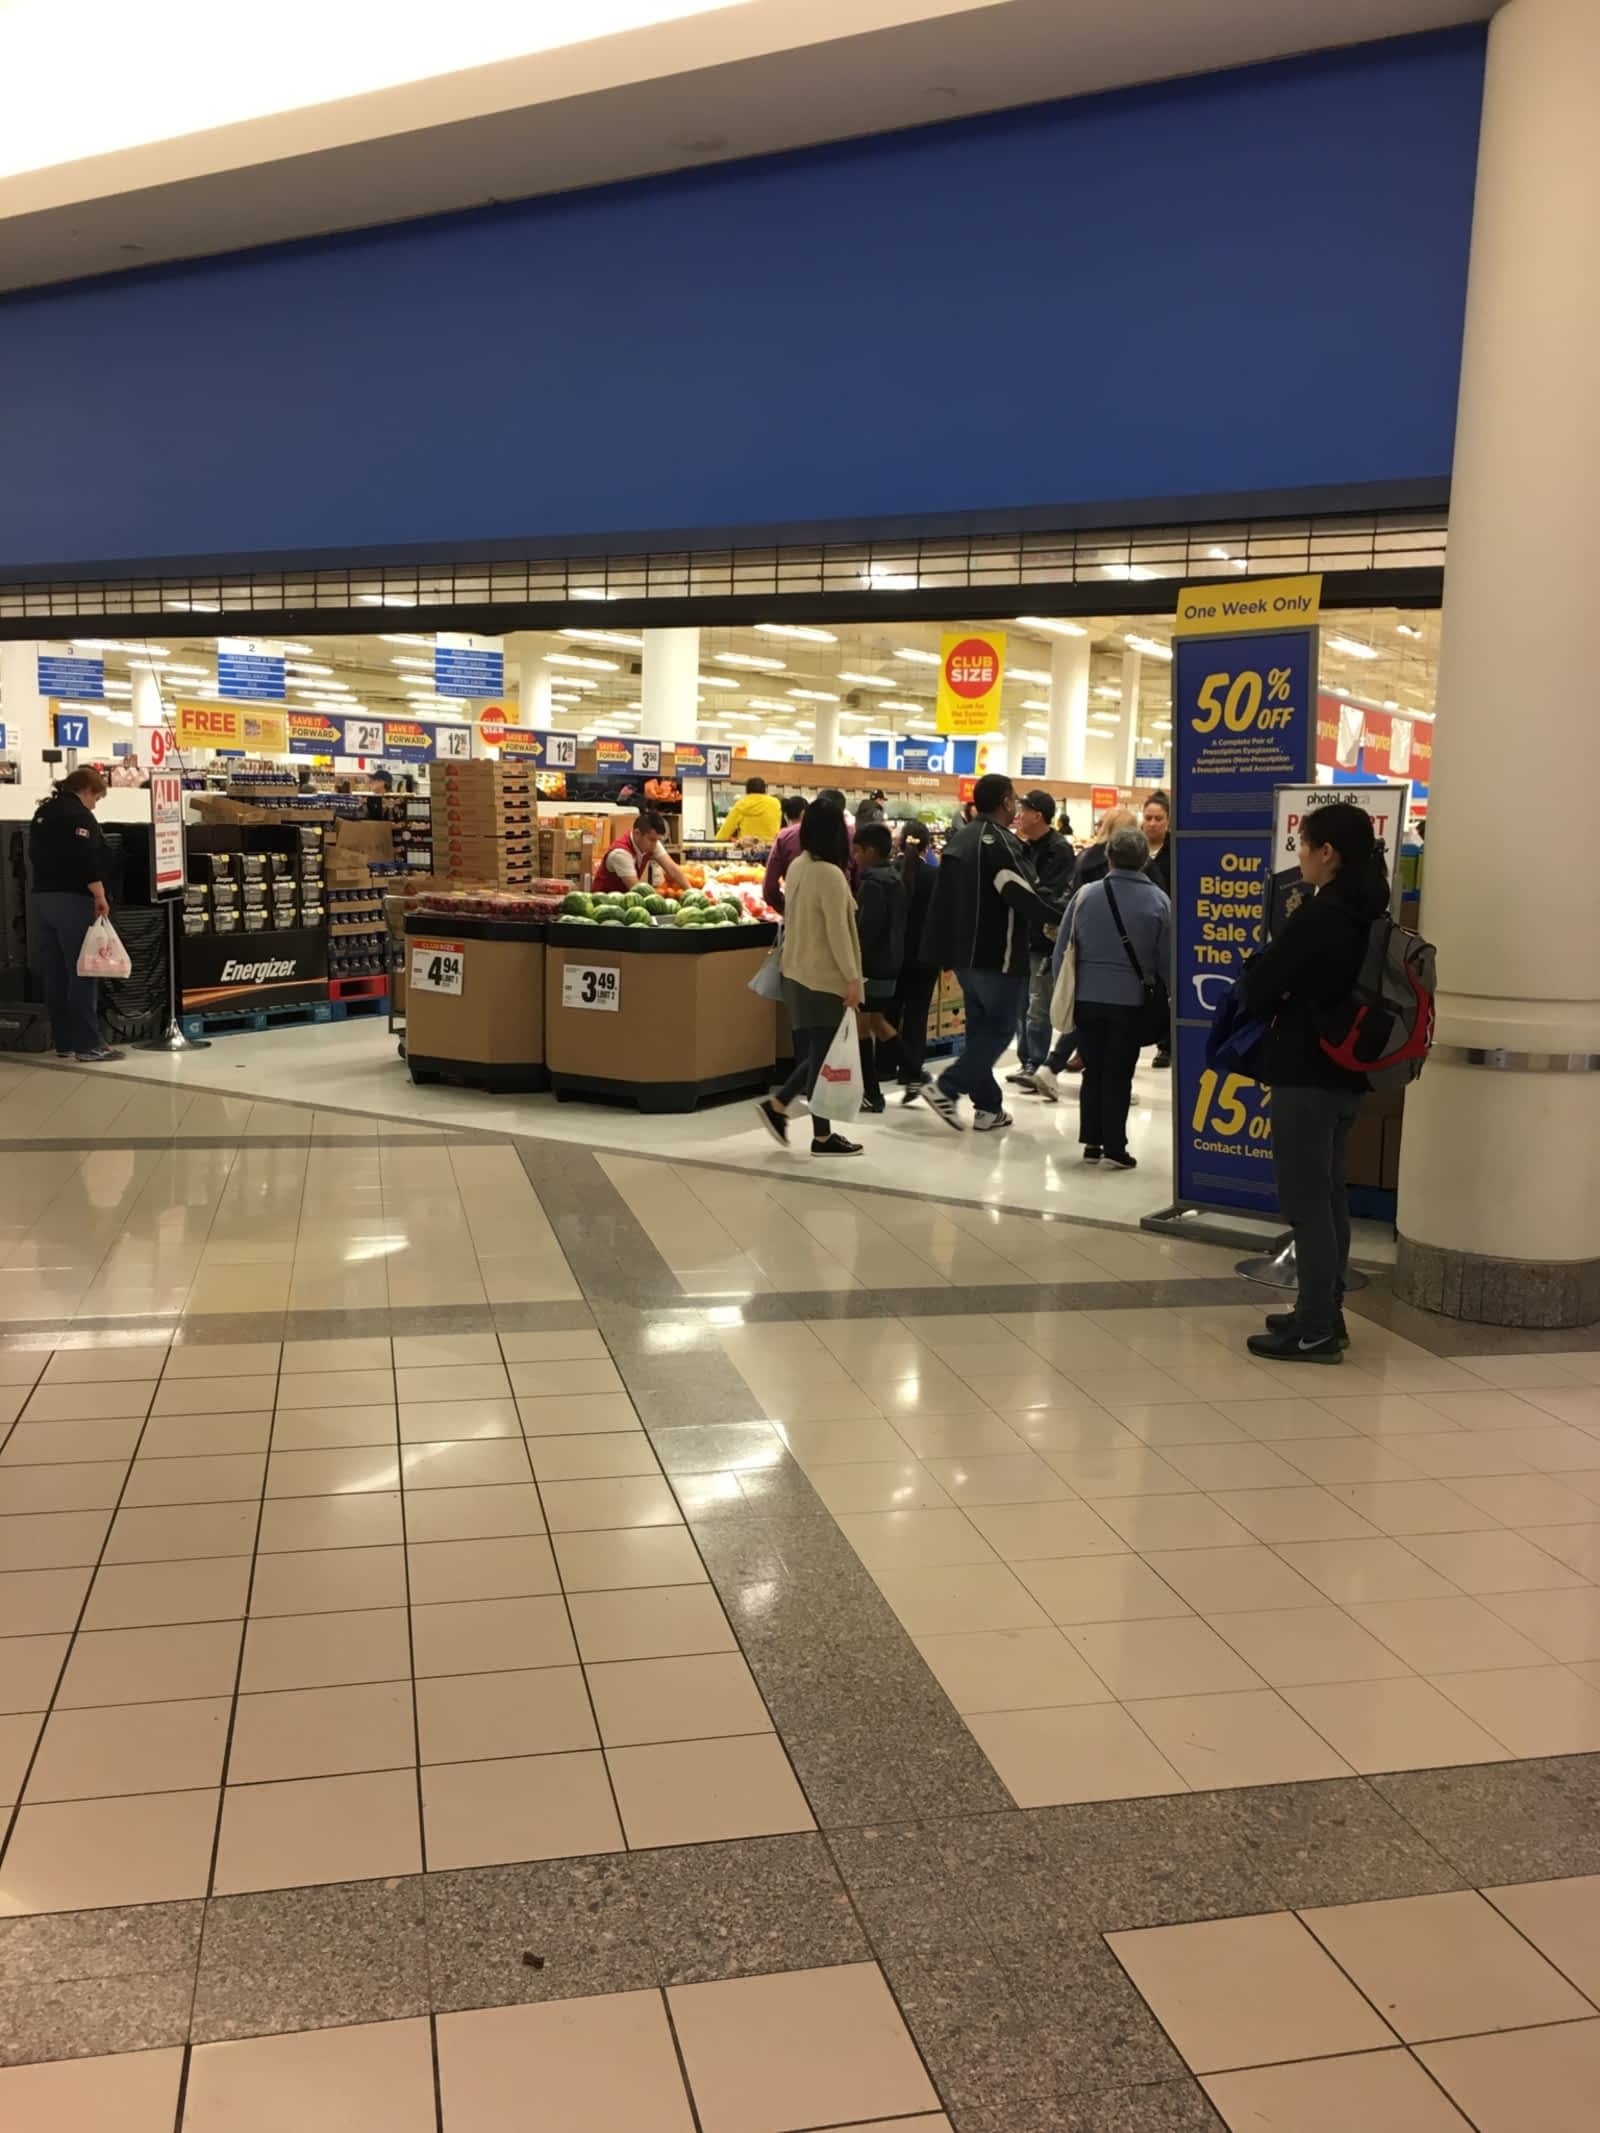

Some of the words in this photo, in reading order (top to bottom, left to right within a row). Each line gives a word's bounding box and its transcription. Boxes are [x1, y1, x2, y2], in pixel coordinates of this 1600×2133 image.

[1184, 605, 1217, 620] One
[1222, 600, 1267, 616] Week
[1273, 594, 1312, 612] Only
[248, 643, 256, 653] 2
[951, 655, 993, 668] CLUB
[951, 667, 993, 683] SIZE
[181, 709, 237, 733] FREE
[1257, 707, 1295, 730] OFF
[62, 721, 84, 742] 17
[291, 728, 335, 739] FORWARD
[388, 735, 426, 746] FORWARD
[505, 744, 538, 753] FORWARD
[1220, 853, 1262, 872] Our
[1200, 876, 1265, 899] Bigge
[1197, 899, 1264, 921] Eyewe
[1202, 923, 1247, 942] Sale
[1193, 945, 1233, 964] The
[220, 957, 297, 983] Energizer
[1193, 1138, 1242, 1155] Contact
